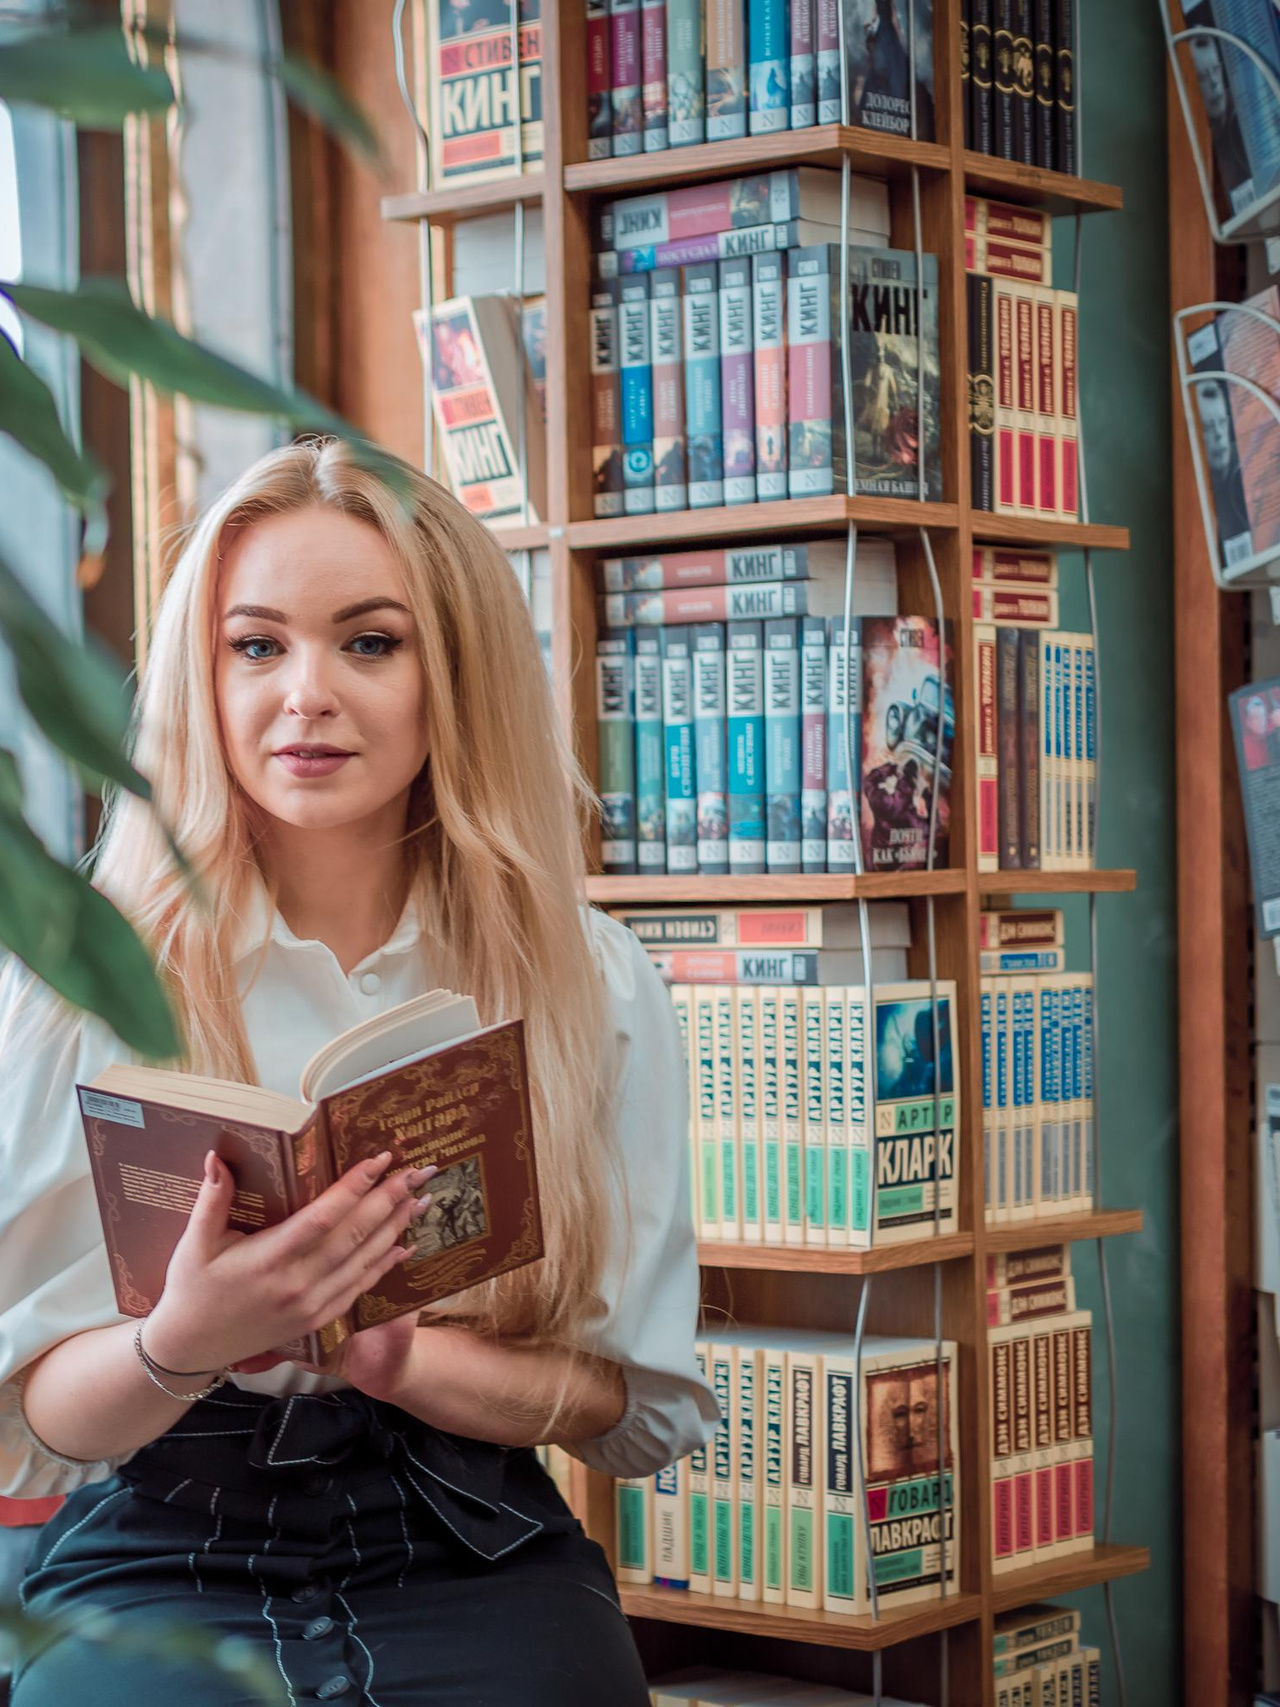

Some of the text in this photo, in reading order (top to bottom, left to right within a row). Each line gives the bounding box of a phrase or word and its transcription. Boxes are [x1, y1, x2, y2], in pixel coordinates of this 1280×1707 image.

[465, 30, 539, 68] СТИВН
[443, 65, 541, 133] КИНГ
[862, 110, 911, 133] КЛЕЙБОР
[723, 228, 770, 255] КИНГ
[627, 306, 645, 362] КИНГ
[659, 304, 675, 357] КИНГ
[693, 300, 711, 352] КИНГ
[727, 294, 745, 346] КИНГ
[760, 289, 777, 341] КИНГ
[800, 283, 818, 336] КИНГ
[732, 551, 777, 578] КИНГ
[731, 587, 777, 614] КИНГ
[640, 663, 656, 713] КИНГ
[669, 668, 687, 717] КИНГ
[700, 660, 718, 710] КИНГ
[734, 655, 756, 711] КИНГ
[771, 657, 790, 709] КИНГ
[805, 655, 823, 707] КИНГ
[742, 956, 787, 979] КИНГ
[785, 1004, 799, 1117] АРТУР КЛАРК
[807, 1005, 822, 1120] АРТУР КЛАРК
[829, 1005, 844, 1121] АРТУР КЛАРК
[850, 1005, 865, 1121] АРТУР КЛАРК
[898, 1104, 954, 1128] АРТР
[878, 1133, 952, 1184] КЛАРК
[795, 1372, 809, 1445] ЛАВКРАФТ
[997, 1347, 1009, 1454] ДЭН СИММОНС
[1017, 1341, 1029, 1449] ДЭН СИММОНС
[1038, 1338, 1049, 1444] ДЭН СИММОНС
[1056, 1333, 1069, 1439] ДЭН СИММОНС
[1076, 1330, 1089, 1436] ДЭН СИММОНС
[740, 1364, 753, 1476] АРТУР КЛАРК
[766, 1372, 781, 1481] АРТУР КЛАРК
[832, 1376, 848, 1491] ГОВАРД ЛАВКРАФТ
[714, 1425, 728, 1476] АРТУР
[661, 1510, 675, 1563] ПАДШИЕ
